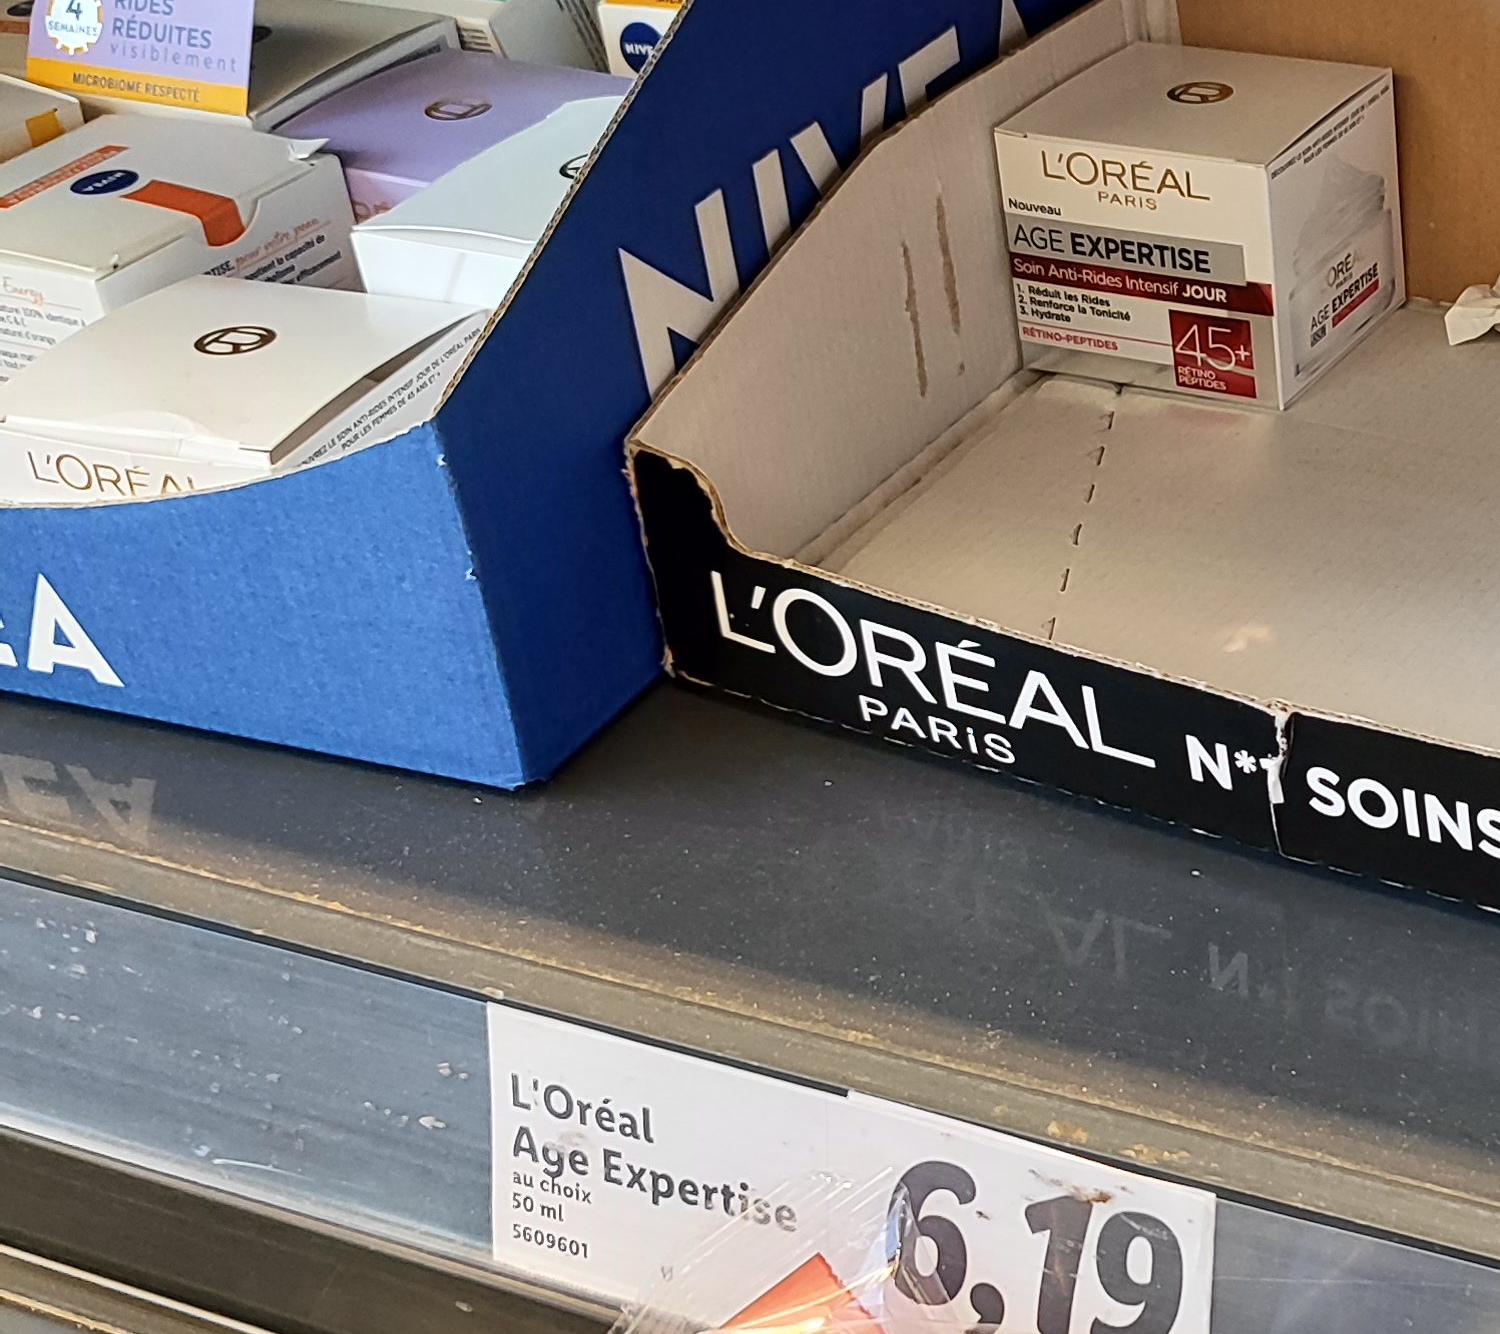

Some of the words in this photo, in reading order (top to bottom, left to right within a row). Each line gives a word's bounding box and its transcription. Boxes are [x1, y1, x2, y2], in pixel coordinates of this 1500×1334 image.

[48, 19, 99, 37] SEMAINES
[112, 15, 212, 49] RÉDUITES
[111, 43, 237, 73] visiblement
[73, 72, 141, 94] MICROBIOME
[145, 82, 200, 103] RESPECTÉ
[1041, 150, 1211, 201] L'ORÉAL
[1008, 198, 1062, 216] Nouveau
[1097, 191, 1158, 211] PARIS
[1014, 223, 1065, 253] AGE
[1070, 232, 1211, 274] EXPERTISE
[1014, 258, 1045, 276] Soin
[1048, 263, 1122, 289] Anti-Rides
[1125, 276, 1179, 297] Intensif
[1182, 283, 1228, 303] JOUR
[1016, 283, 1025, 294] 1.
[1028, 285, 1061, 301] Réduit
[1063, 290, 1079, 302] les
[1081, 292, 1110, 308] Rides
[1331, 262, 1379, 314] EXPERTISE
[1018, 295, 1028, 305] 2.
[1029, 296, 1075, 313] Renforce
[1089, 304, 1131, 322] Tonicité
[1020, 305, 1029, 316] 3.
[1031, 307, 1071, 323] Hydrate
[1022, 326, 1119, 351] RÉTINO-PEPTIDES
[1174, 323, 1251, 371] 45+
[1177, 365, 1216, 380] RÉTINO
[710, 570, 1156, 769] L'ORÉAL
[858, 694, 1016, 764] PARIS
[511, 1072, 655, 1144] L'Oréal
[512, 1124, 590, 1178] Age
[602, 1148, 798, 1233] Expertise
[512, 1171, 535, 1188] au
[540, 1175, 592, 1205] choix
[511, 1191, 535, 1214] 50
[540, 1201, 565, 1222] ml
[512, 1222, 590, 1259] 5609601
